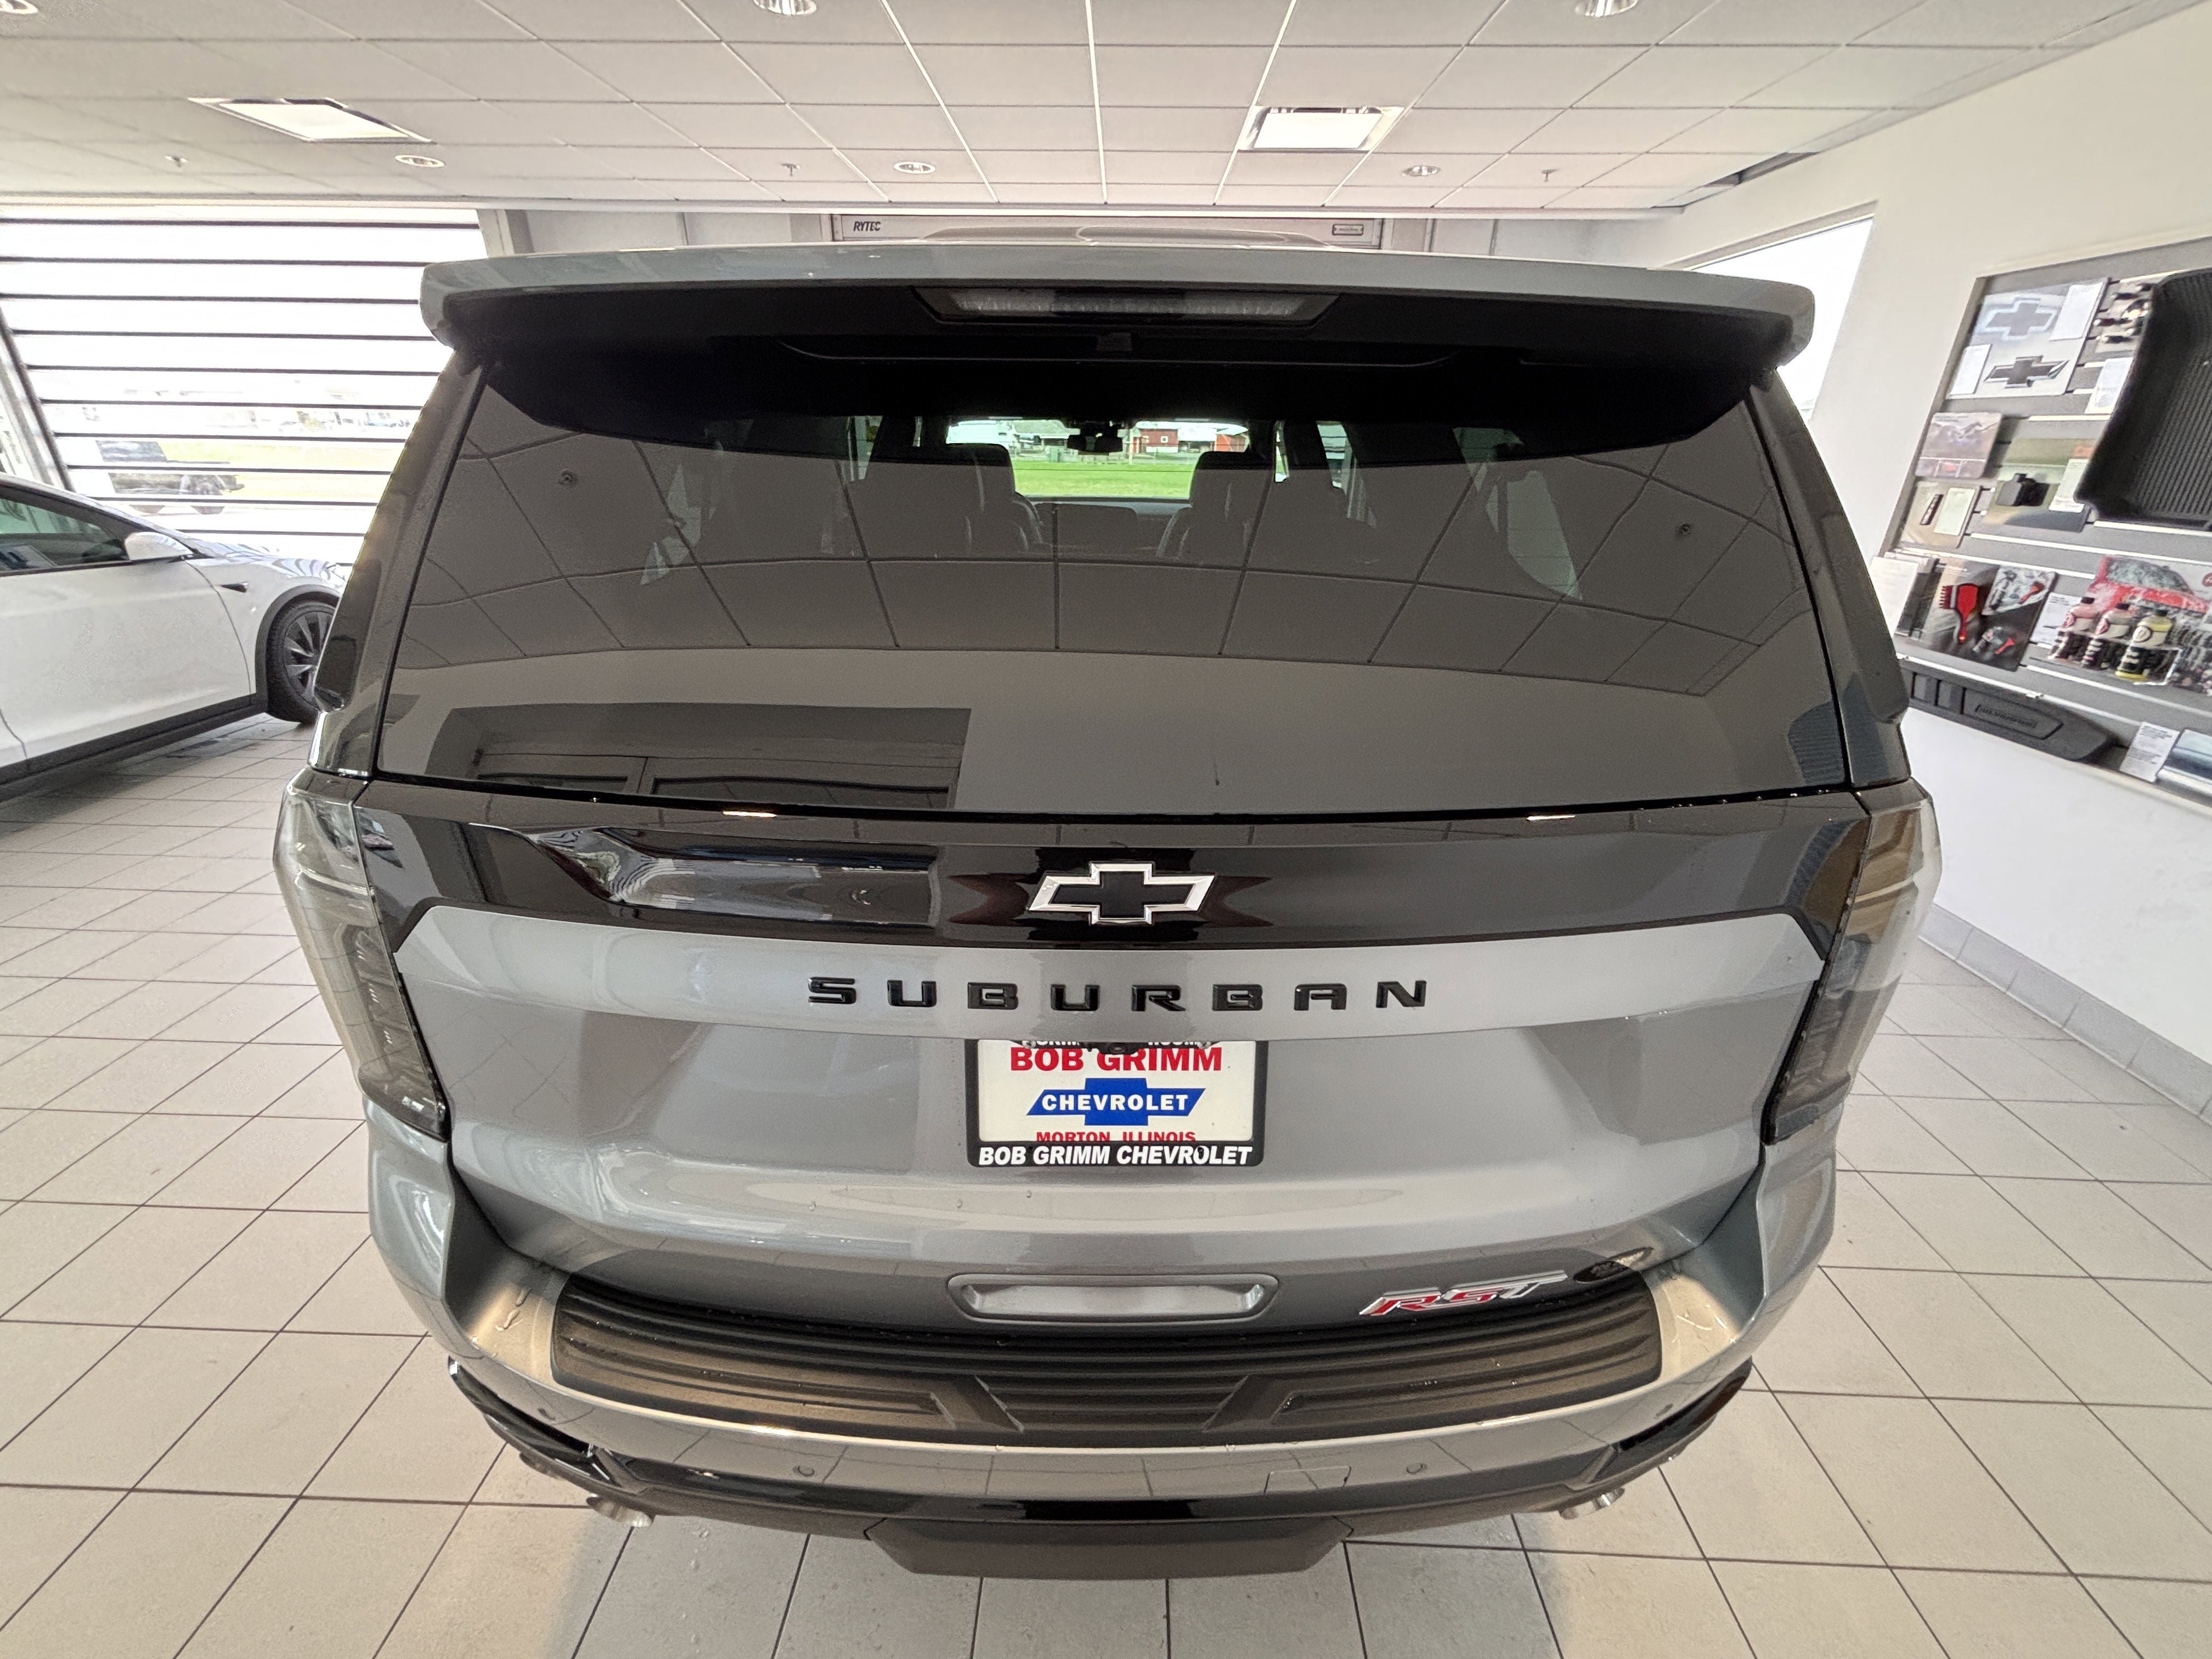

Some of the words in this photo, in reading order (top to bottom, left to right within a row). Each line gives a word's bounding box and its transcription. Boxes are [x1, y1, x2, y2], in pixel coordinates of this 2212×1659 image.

[853, 221, 881, 232] RYTEC
[808, 976, 1427, 1012] SUBURBAN
[1011, 1047, 1084, 1071] BOB
[1097, 1047, 1222, 1071] GRIMM
[1042, 1094, 1188, 1111] CHEVROLET
[1036, 1131, 1110, 1142] MORTON
[978, 1146, 1027, 1166] BOB
[1033, 1146, 1110, 1165] GRIMM
[1116, 1145, 1253, 1165] CHEVROLET
[1359, 1269, 1568, 1317] RST
